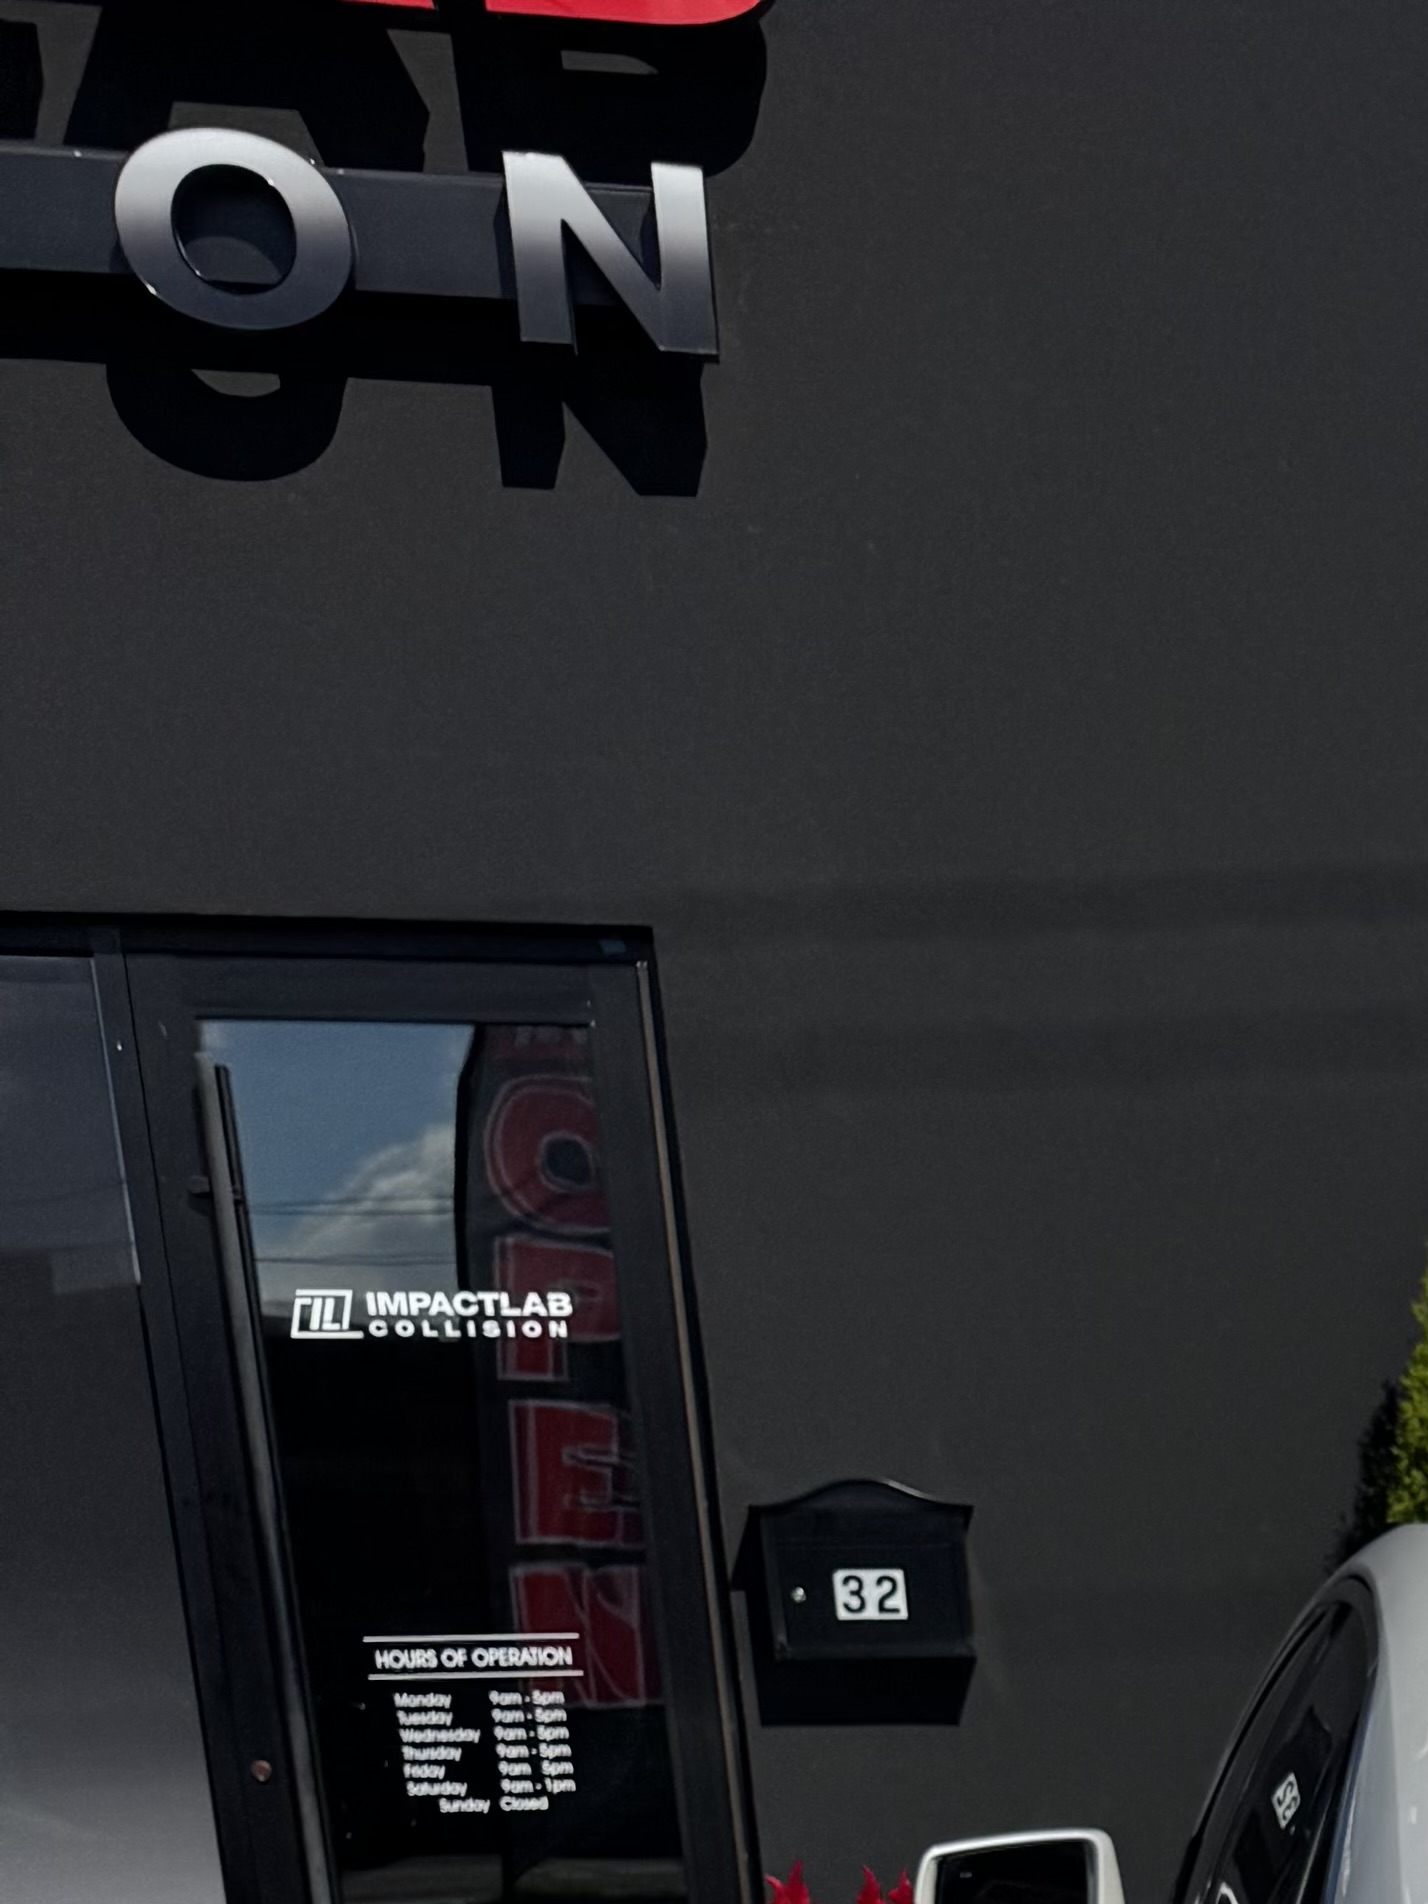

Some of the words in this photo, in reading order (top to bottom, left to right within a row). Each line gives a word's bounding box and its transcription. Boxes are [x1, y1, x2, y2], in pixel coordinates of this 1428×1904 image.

[365, 1292, 573, 1317] IMPACTLAB
[369, 1319, 568, 1338] COLLISION
[842, 1575, 901, 1613] 32
[375, 1649, 438, 1669] HOURS
[440, 1648, 468, 1668] OF
[471, 1646, 573, 1667] OPERATION
[394, 1693, 452, 1709] Monday
[397, 1711, 453, 1726] Tuesday
[398, 1727, 480, 1743] Wednesday
[402, 1745, 462, 1761] Thursday
[403, 1763, 446, 1780] Friday
[406, 1781, 467, 1797] Saturday
[439, 1798, 490, 1814] Sunday
[500, 1796, 549, 1811] Closed
